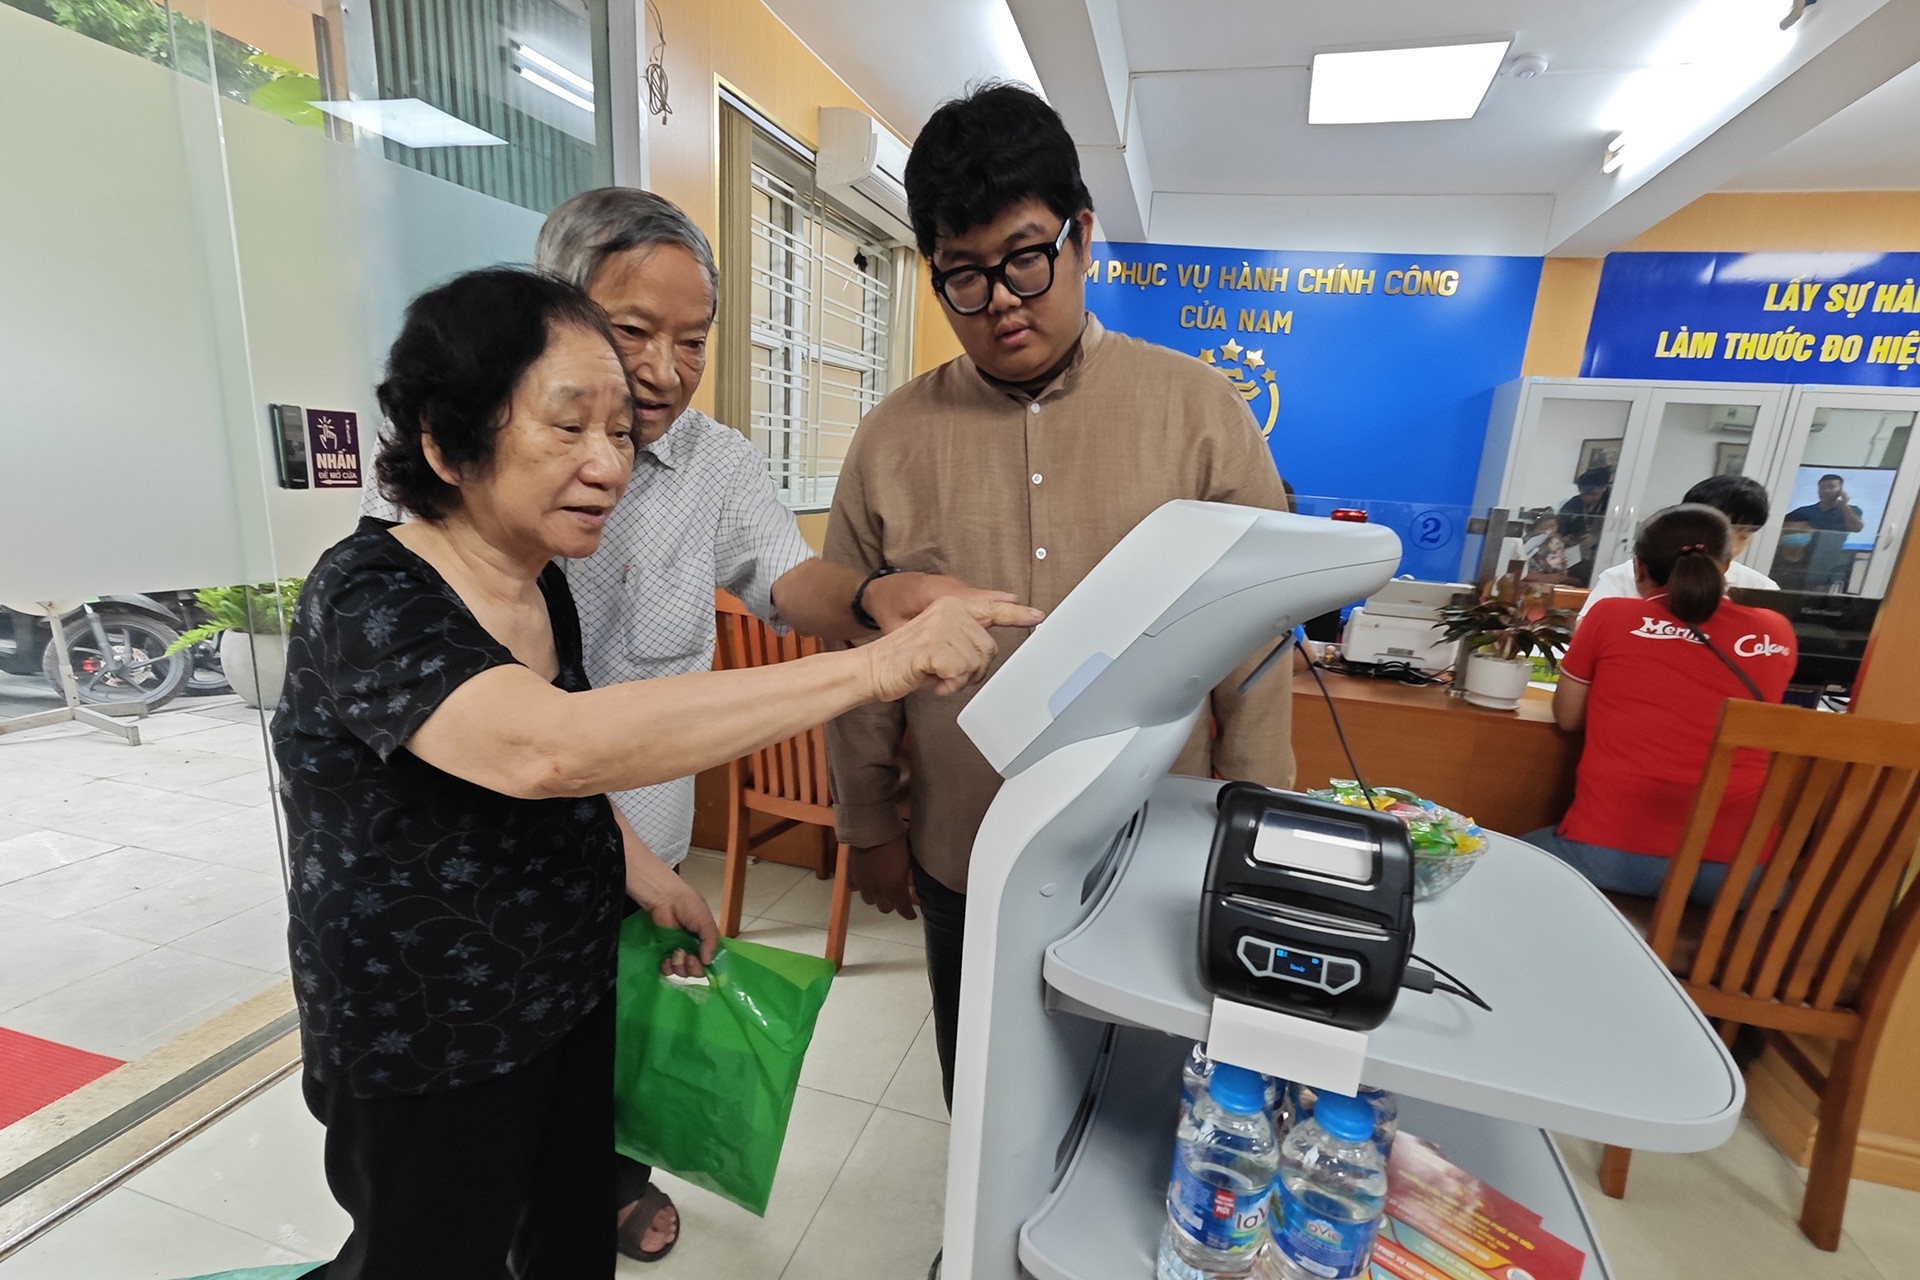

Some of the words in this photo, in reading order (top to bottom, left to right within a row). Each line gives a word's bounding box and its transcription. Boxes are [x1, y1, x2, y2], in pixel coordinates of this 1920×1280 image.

[1084, 260, 1100, 284] M
[1106, 260, 1168, 291] PHỤC
[1178, 263, 1211, 293] VỤ
[1219, 261, 1289, 292] HÀNH
[1297, 263, 1376, 295] CHÍNH
[1384, 264, 1460, 296] CÔNG
[1763, 273, 1822, 312] LẤY
[1824, 280, 1875, 319] SỰ
[1871, 278, 1920, 313] HÀ
[1180, 301, 1227, 331] CỬA
[1238, 308, 1293, 335] NAM
[1654, 326, 1718, 359] LÀM
[1724, 326, 1816, 362] THƯỚC
[1819, 334, 1863, 363] ĐO
[1866, 330, 1920, 371] HIỆ
[316, 448, 357, 469] NHẤN
[1420, 517, 1441, 544] 2
